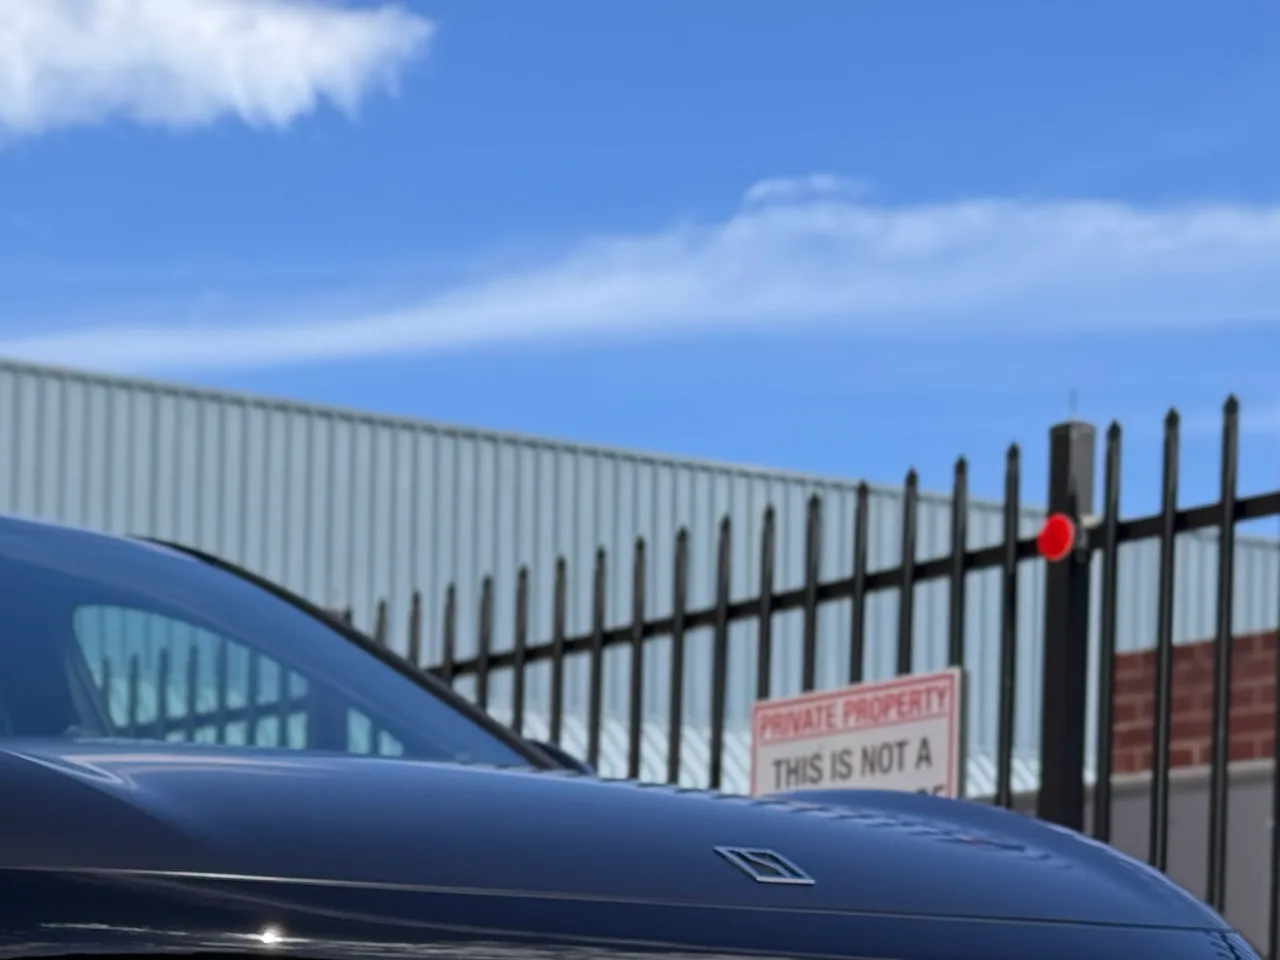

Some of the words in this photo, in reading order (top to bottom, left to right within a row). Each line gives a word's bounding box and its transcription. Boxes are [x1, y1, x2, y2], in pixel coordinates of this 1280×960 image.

[759, 702, 837, 738] PRIVATE
[842, 685, 950, 725] PROPERTY
[773, 753, 824, 789] THIS
[830, 748, 854, 781] IS
[860, 740, 909, 778] NOT
[915, 736, 933, 770] A
